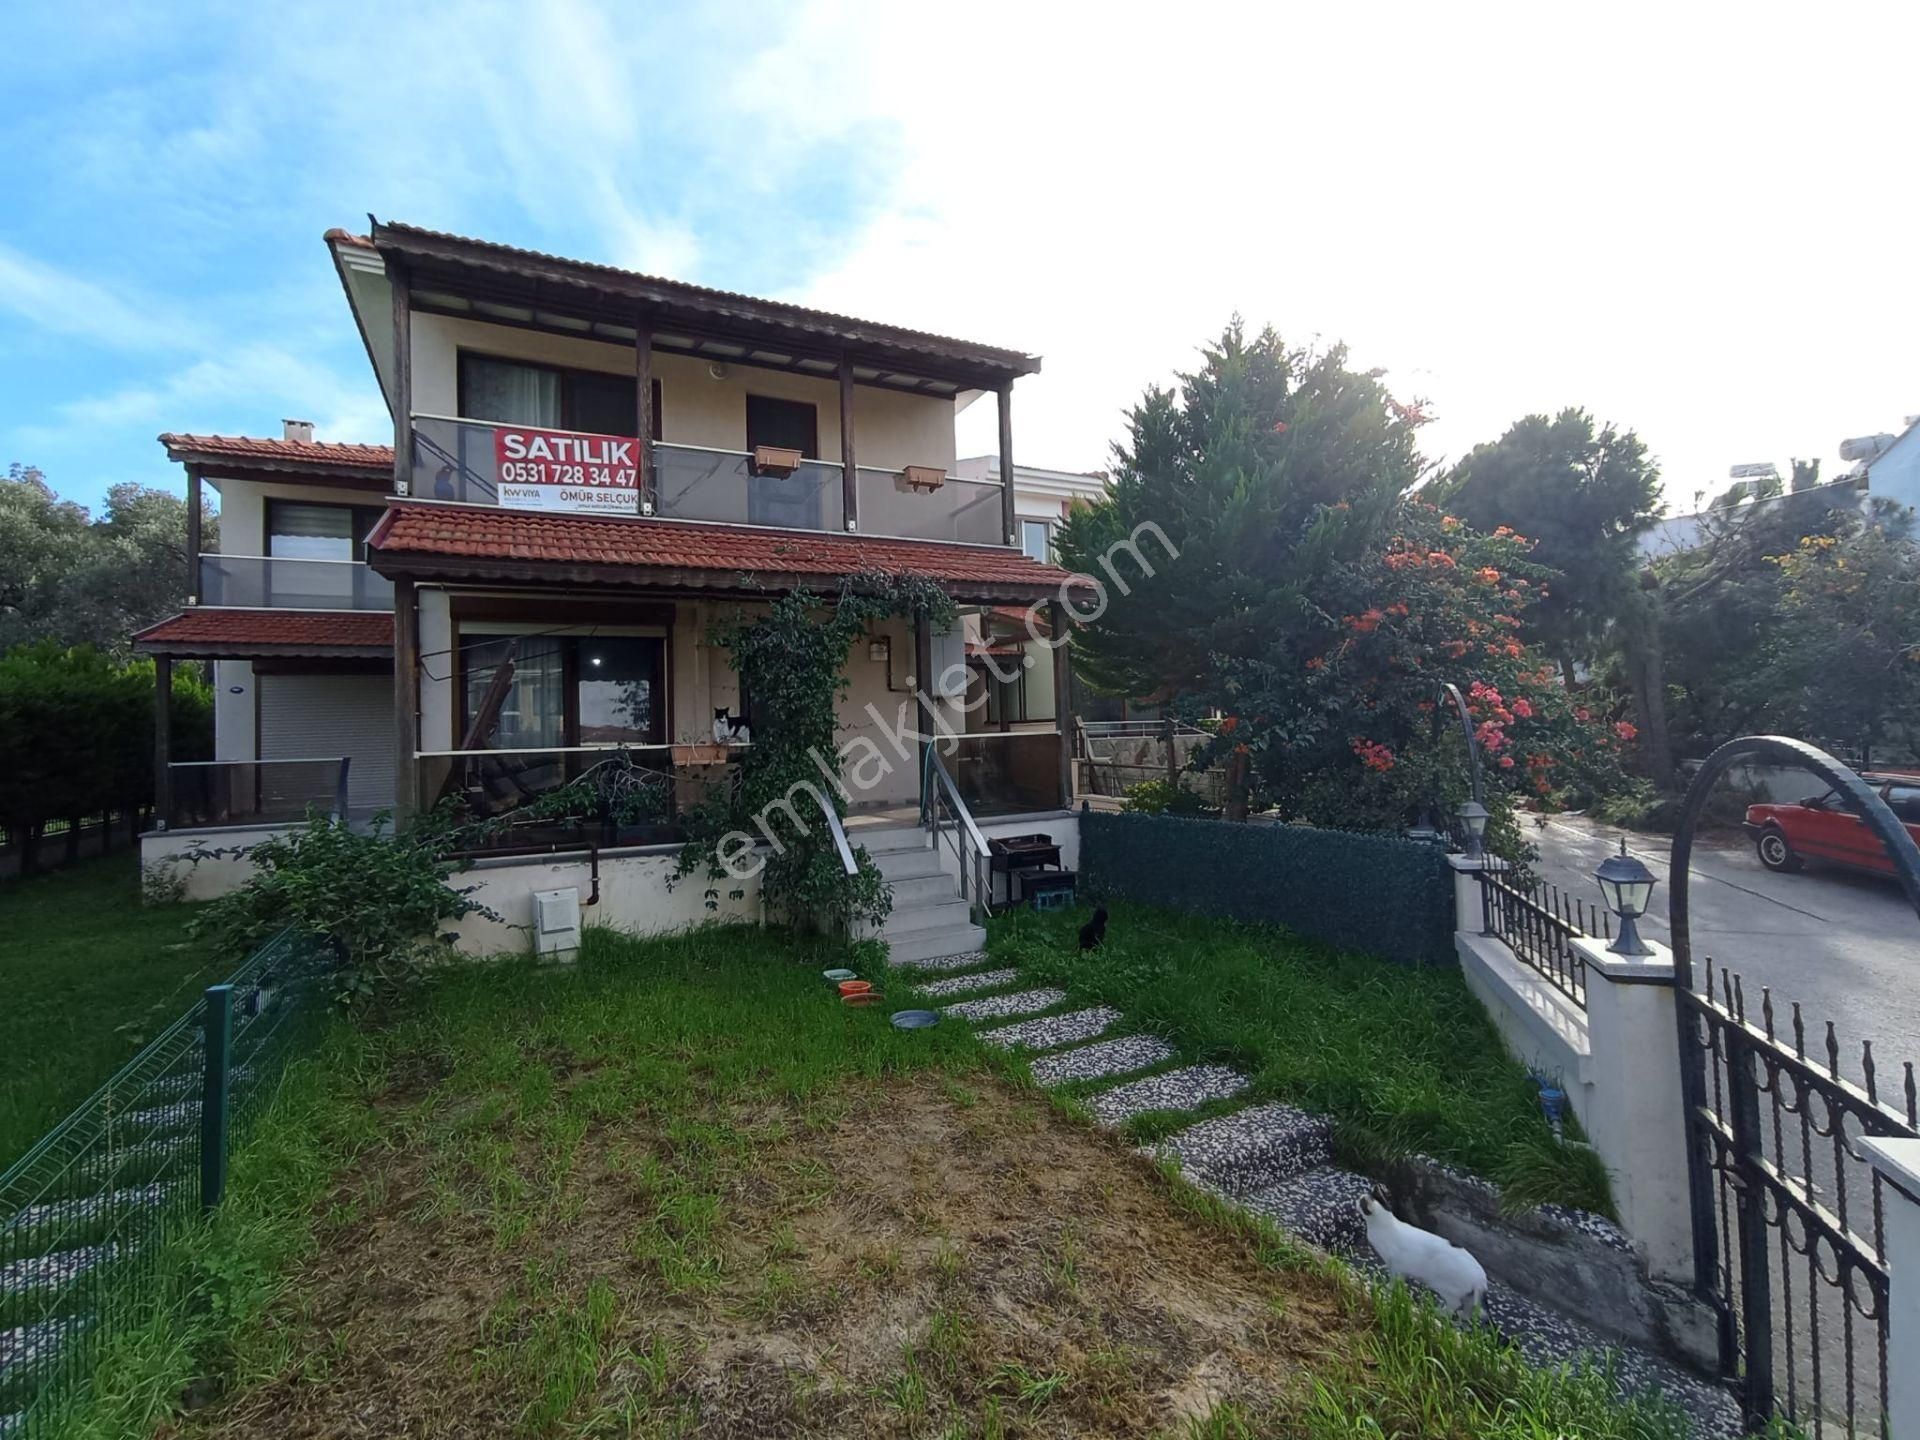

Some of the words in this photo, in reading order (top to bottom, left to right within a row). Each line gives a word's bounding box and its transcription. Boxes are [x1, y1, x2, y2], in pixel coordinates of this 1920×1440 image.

[504, 434, 633, 466] SATILIK
[502, 462, 547, 483] 0531
[551, 464, 584, 484] 728
[589, 467, 611, 486] 34
[615, 469, 637, 488] 47
[560, 488, 594, 502] ÖMÜR
[595, 493, 638, 504] SELÇUK
